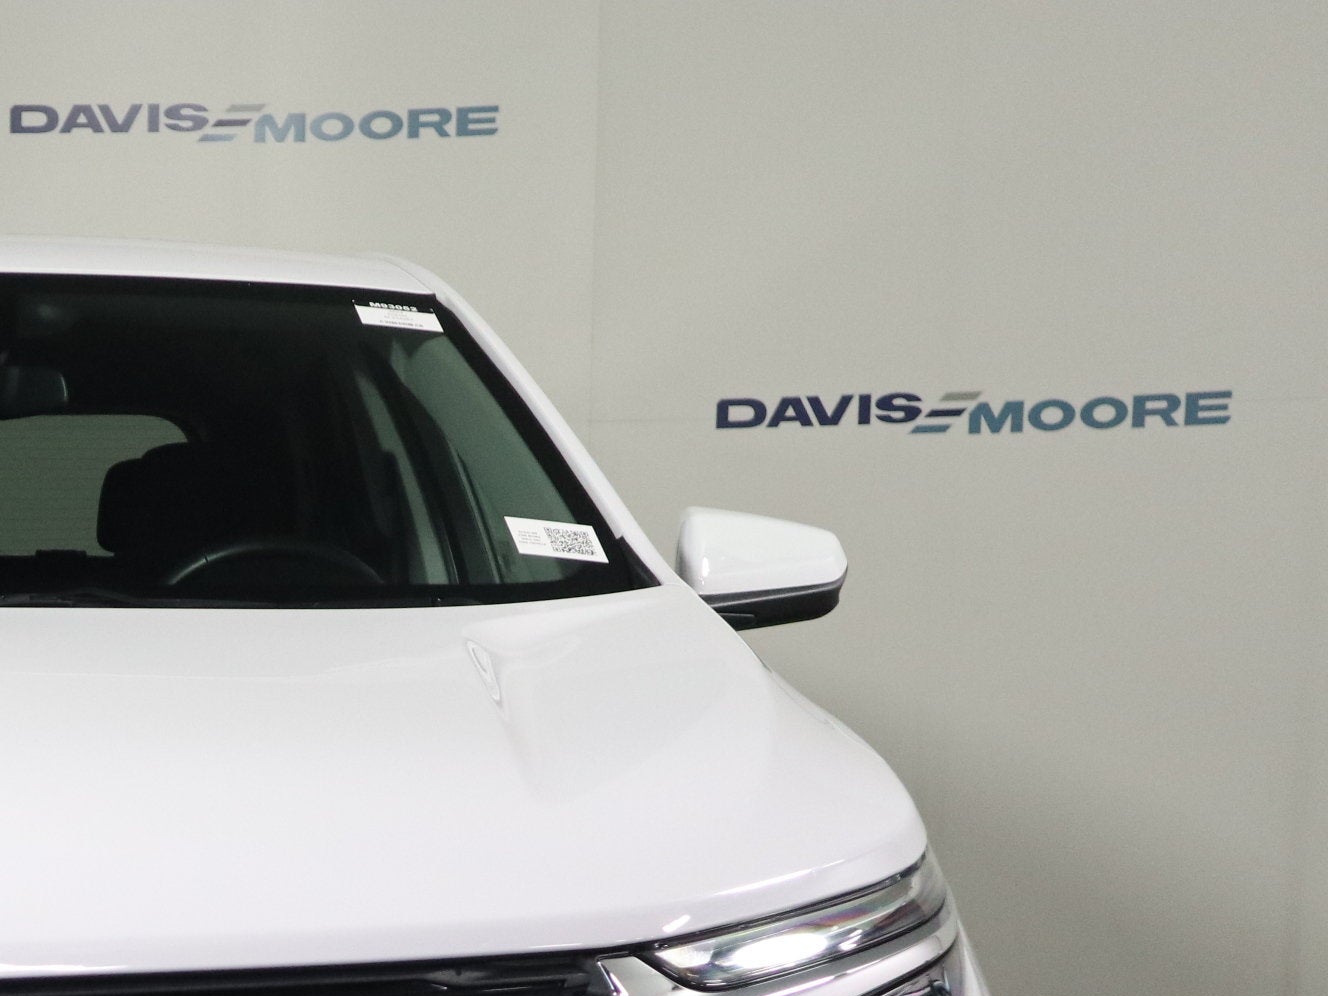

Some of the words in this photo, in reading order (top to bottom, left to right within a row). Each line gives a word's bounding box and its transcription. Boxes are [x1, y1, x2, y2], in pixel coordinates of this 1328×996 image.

[9, 103, 210, 134] DAVIS
[253, 105, 500, 143] MOORE
[715, 392, 924, 430] DAVIS
[966, 390, 1234, 435] MOORE
